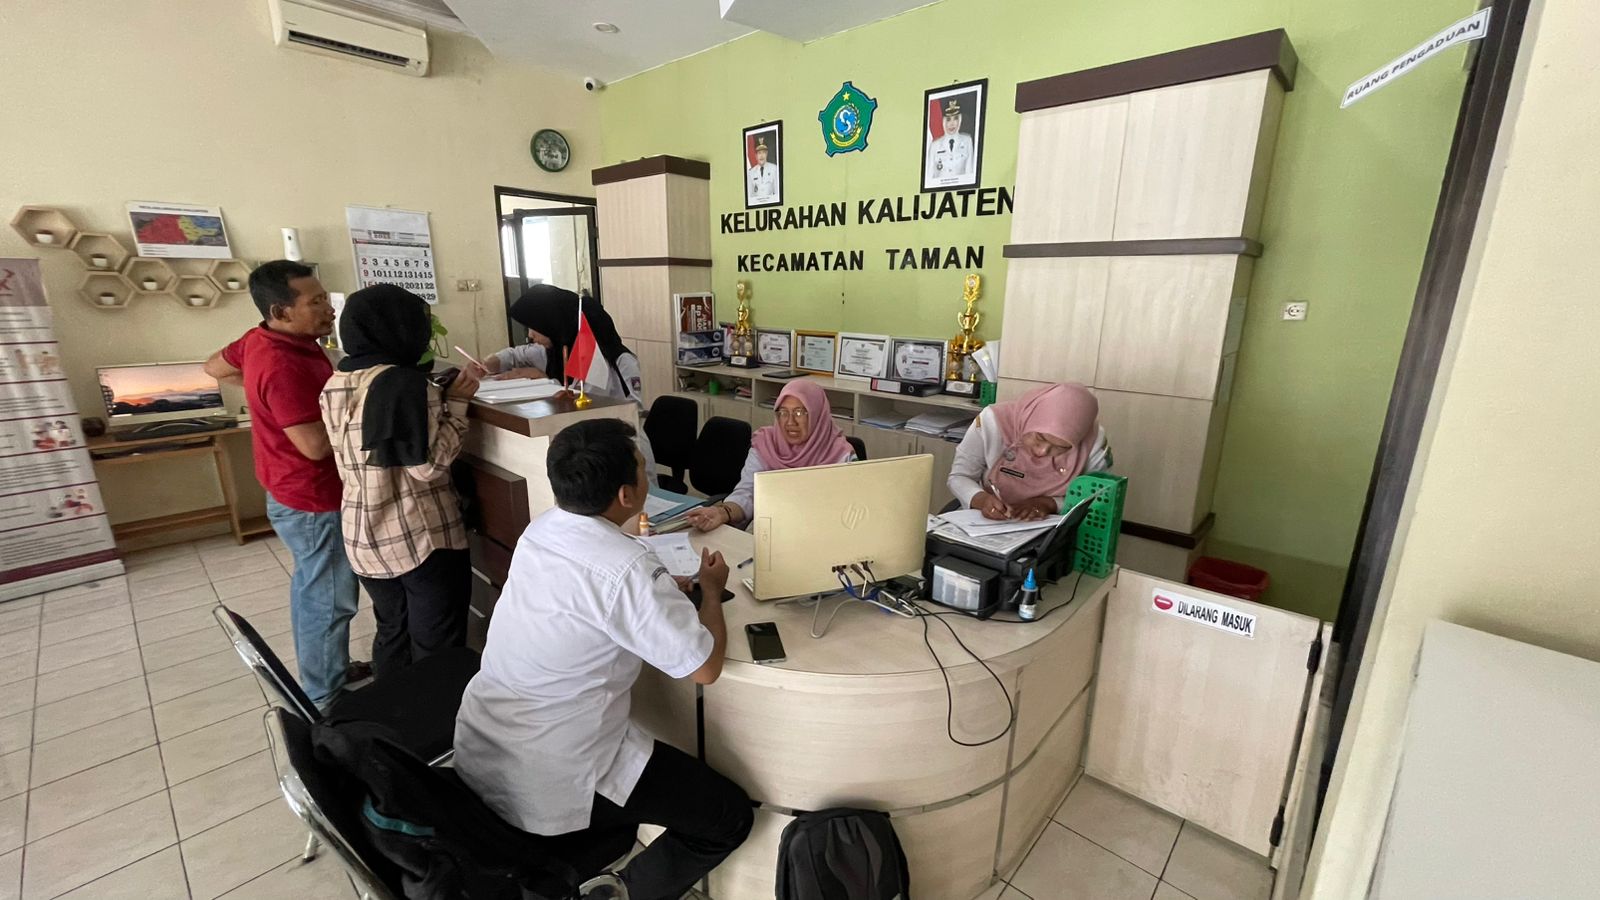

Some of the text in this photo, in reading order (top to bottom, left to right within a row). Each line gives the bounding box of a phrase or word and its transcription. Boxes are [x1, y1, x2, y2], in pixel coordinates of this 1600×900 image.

[1347, 20, 1481, 99] RUANG PENGADUAN
[721, 185, 1015, 234] KELURAHAN KALIJATEN
[372, 258, 378, 266] 3
[394, 259, 400, 267] 5
[737, 246, 985, 272] KECAMATAN TAMAN
[383, 270, 392, 278] 11
[414, 271, 423, 279] 14
[843, 503, 867, 530] hp
[1178, 600, 1253, 633] DILARANG MASUK
